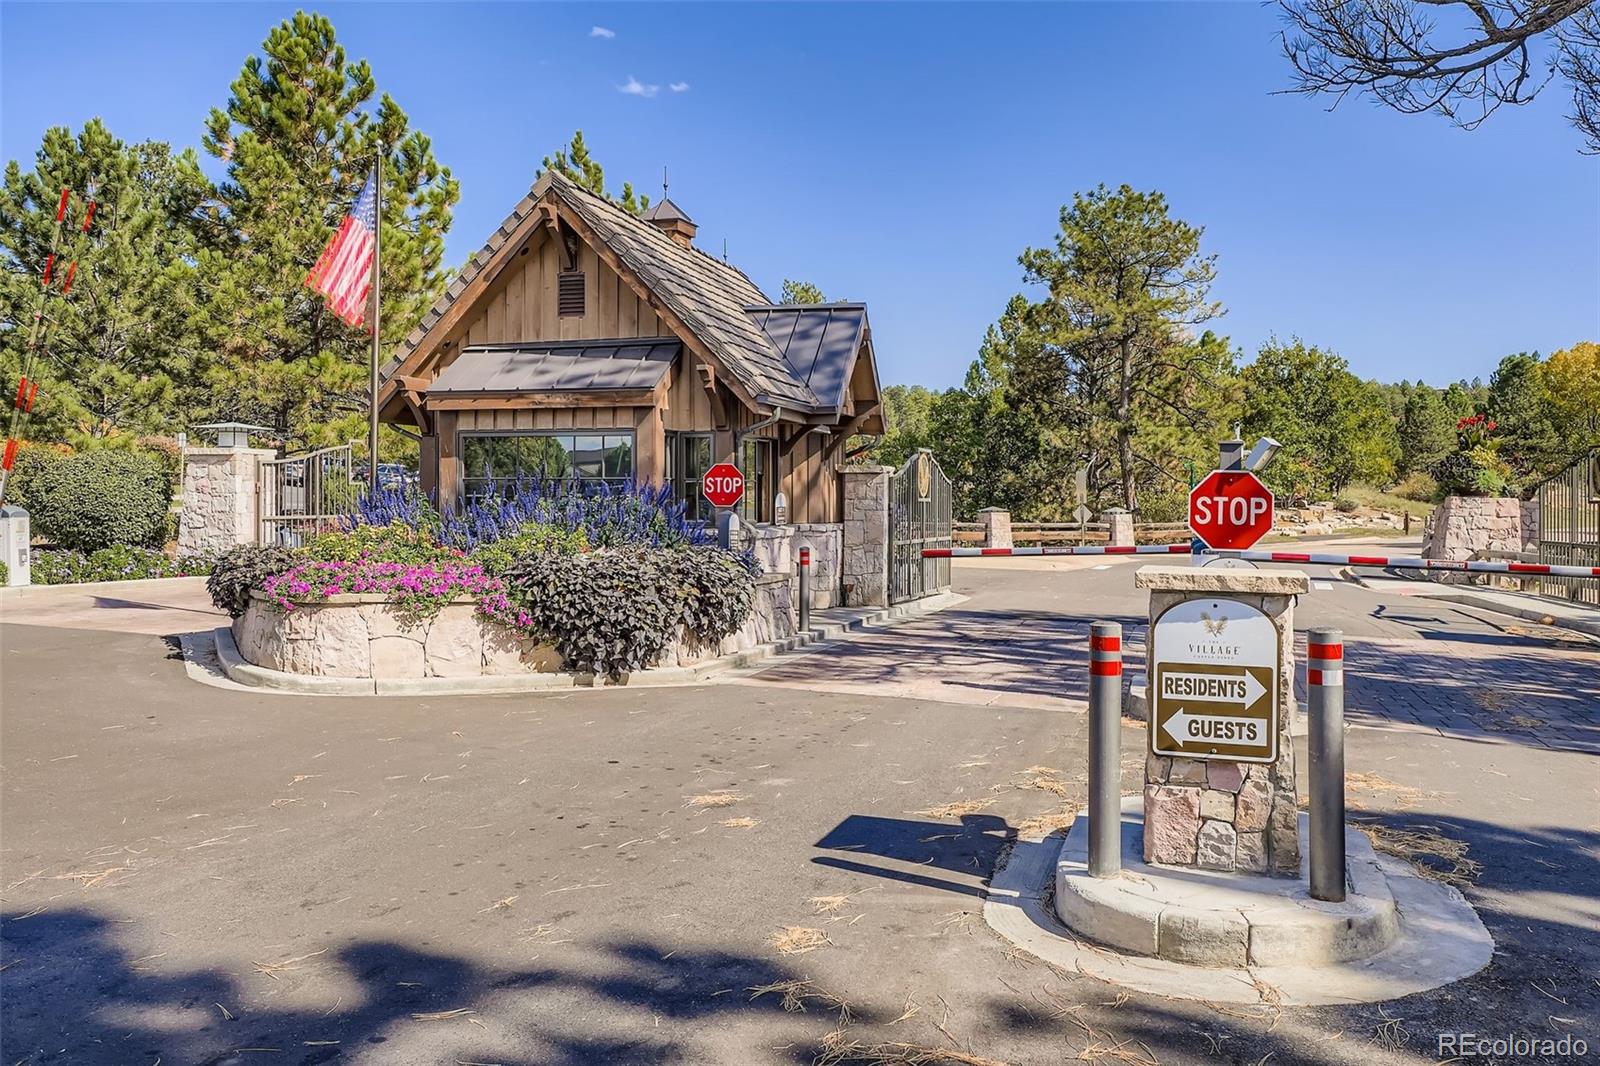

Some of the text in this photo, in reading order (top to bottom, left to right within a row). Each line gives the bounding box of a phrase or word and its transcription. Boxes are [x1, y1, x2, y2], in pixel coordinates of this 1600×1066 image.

[705, 477, 742, 493] STOP
[1194, 496, 1268, 526] STOP
[1188, 643, 1241, 656] VILLAGE
[1164, 676, 1247, 699] RESIDENTS
[1187, 719, 1258, 741] GUESTS
